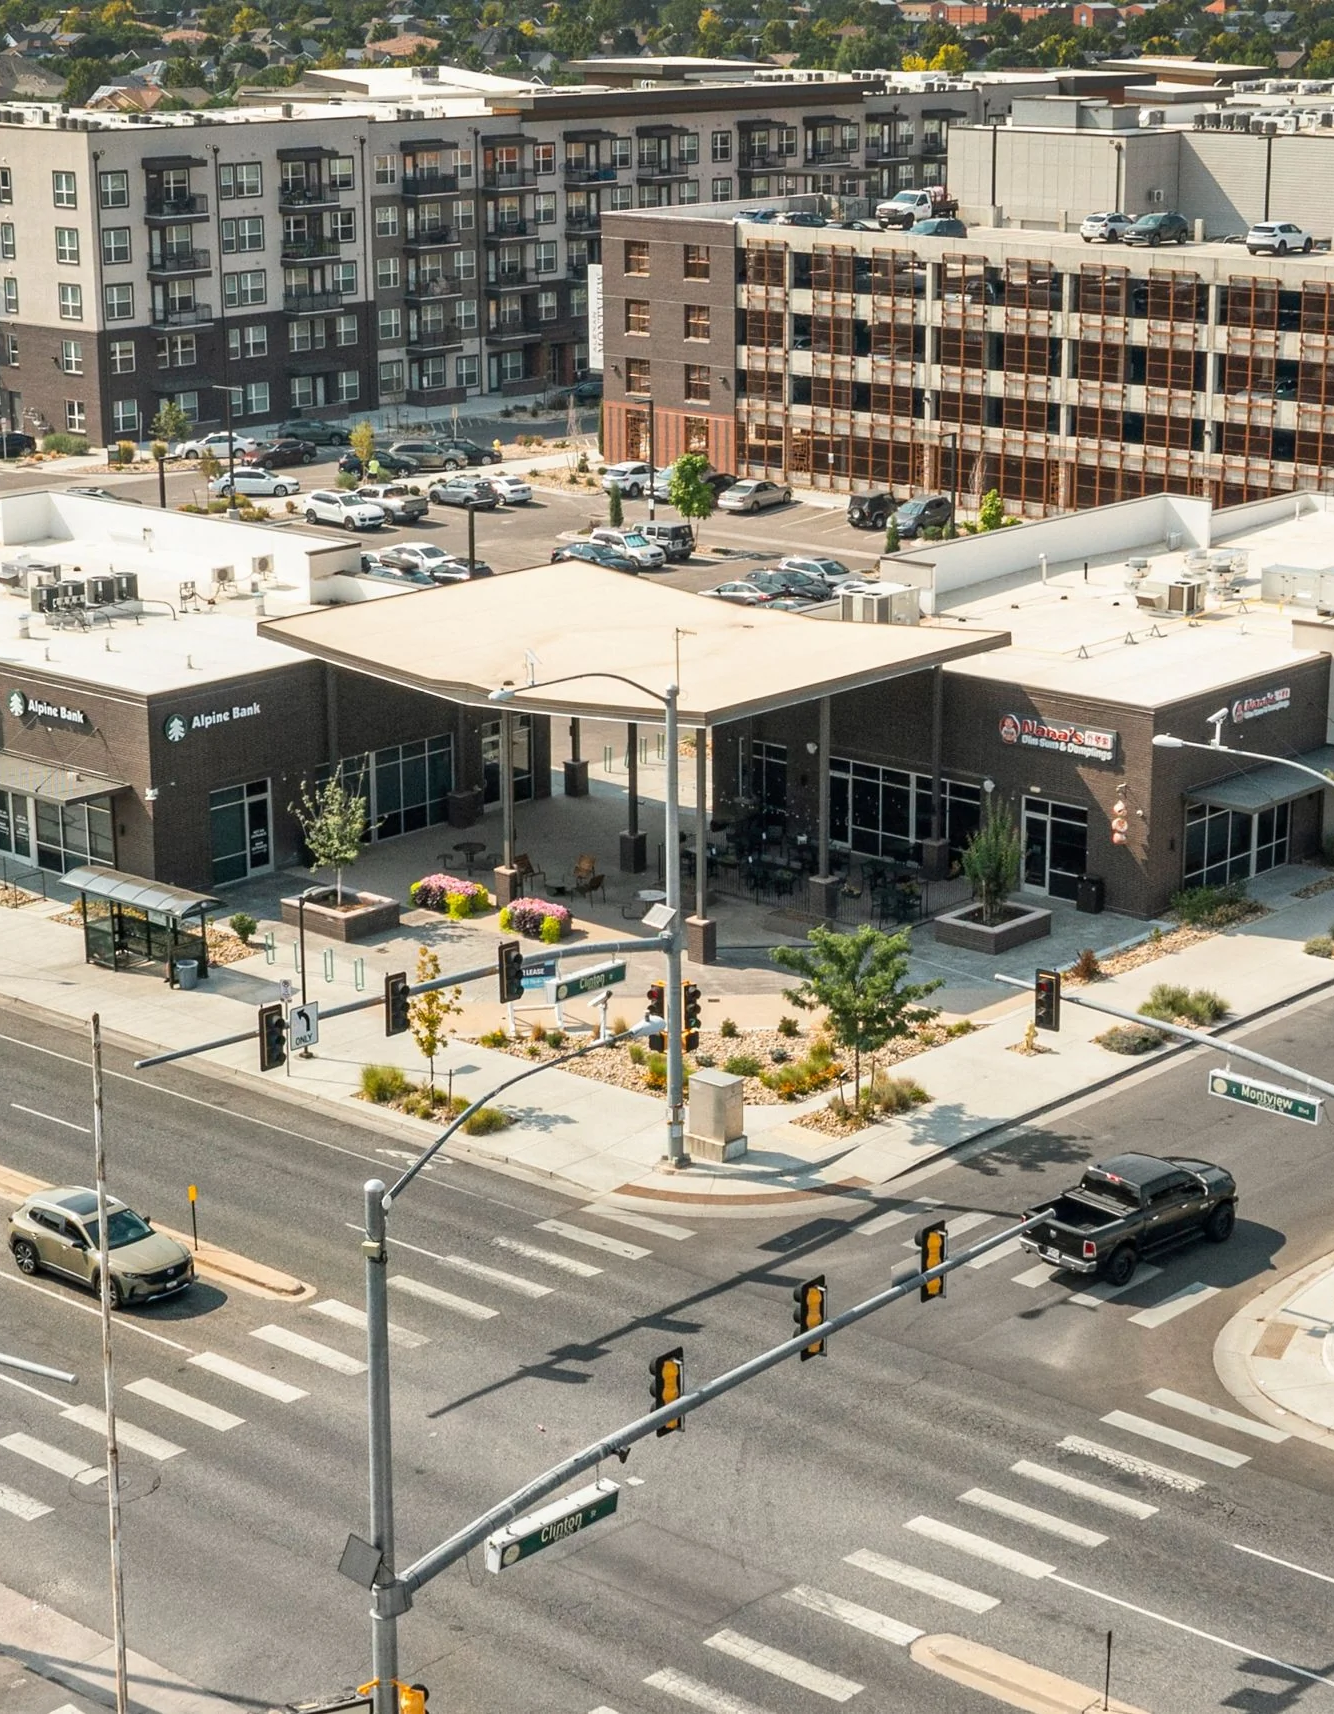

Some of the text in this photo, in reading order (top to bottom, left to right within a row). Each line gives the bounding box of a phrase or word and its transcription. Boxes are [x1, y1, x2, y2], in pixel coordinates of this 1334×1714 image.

[28, 700, 85, 724] Alpine Bank
[191, 703, 261, 729] Alpine Bank
[1021, 719, 1084, 745] Nana's
[1021, 734, 1038, 745] Dim
[1039, 738, 1059, 749] Sum
[1067, 743, 1113, 761] Dumplings
[527, 968, 545, 976] LEASE
[579, 974, 605, 990] Clinton
[295, 1033, 313, 1046] ONLY
[1241, 1085, 1293, 1110] Montview
[540, 1512, 582, 1543] Clinton
